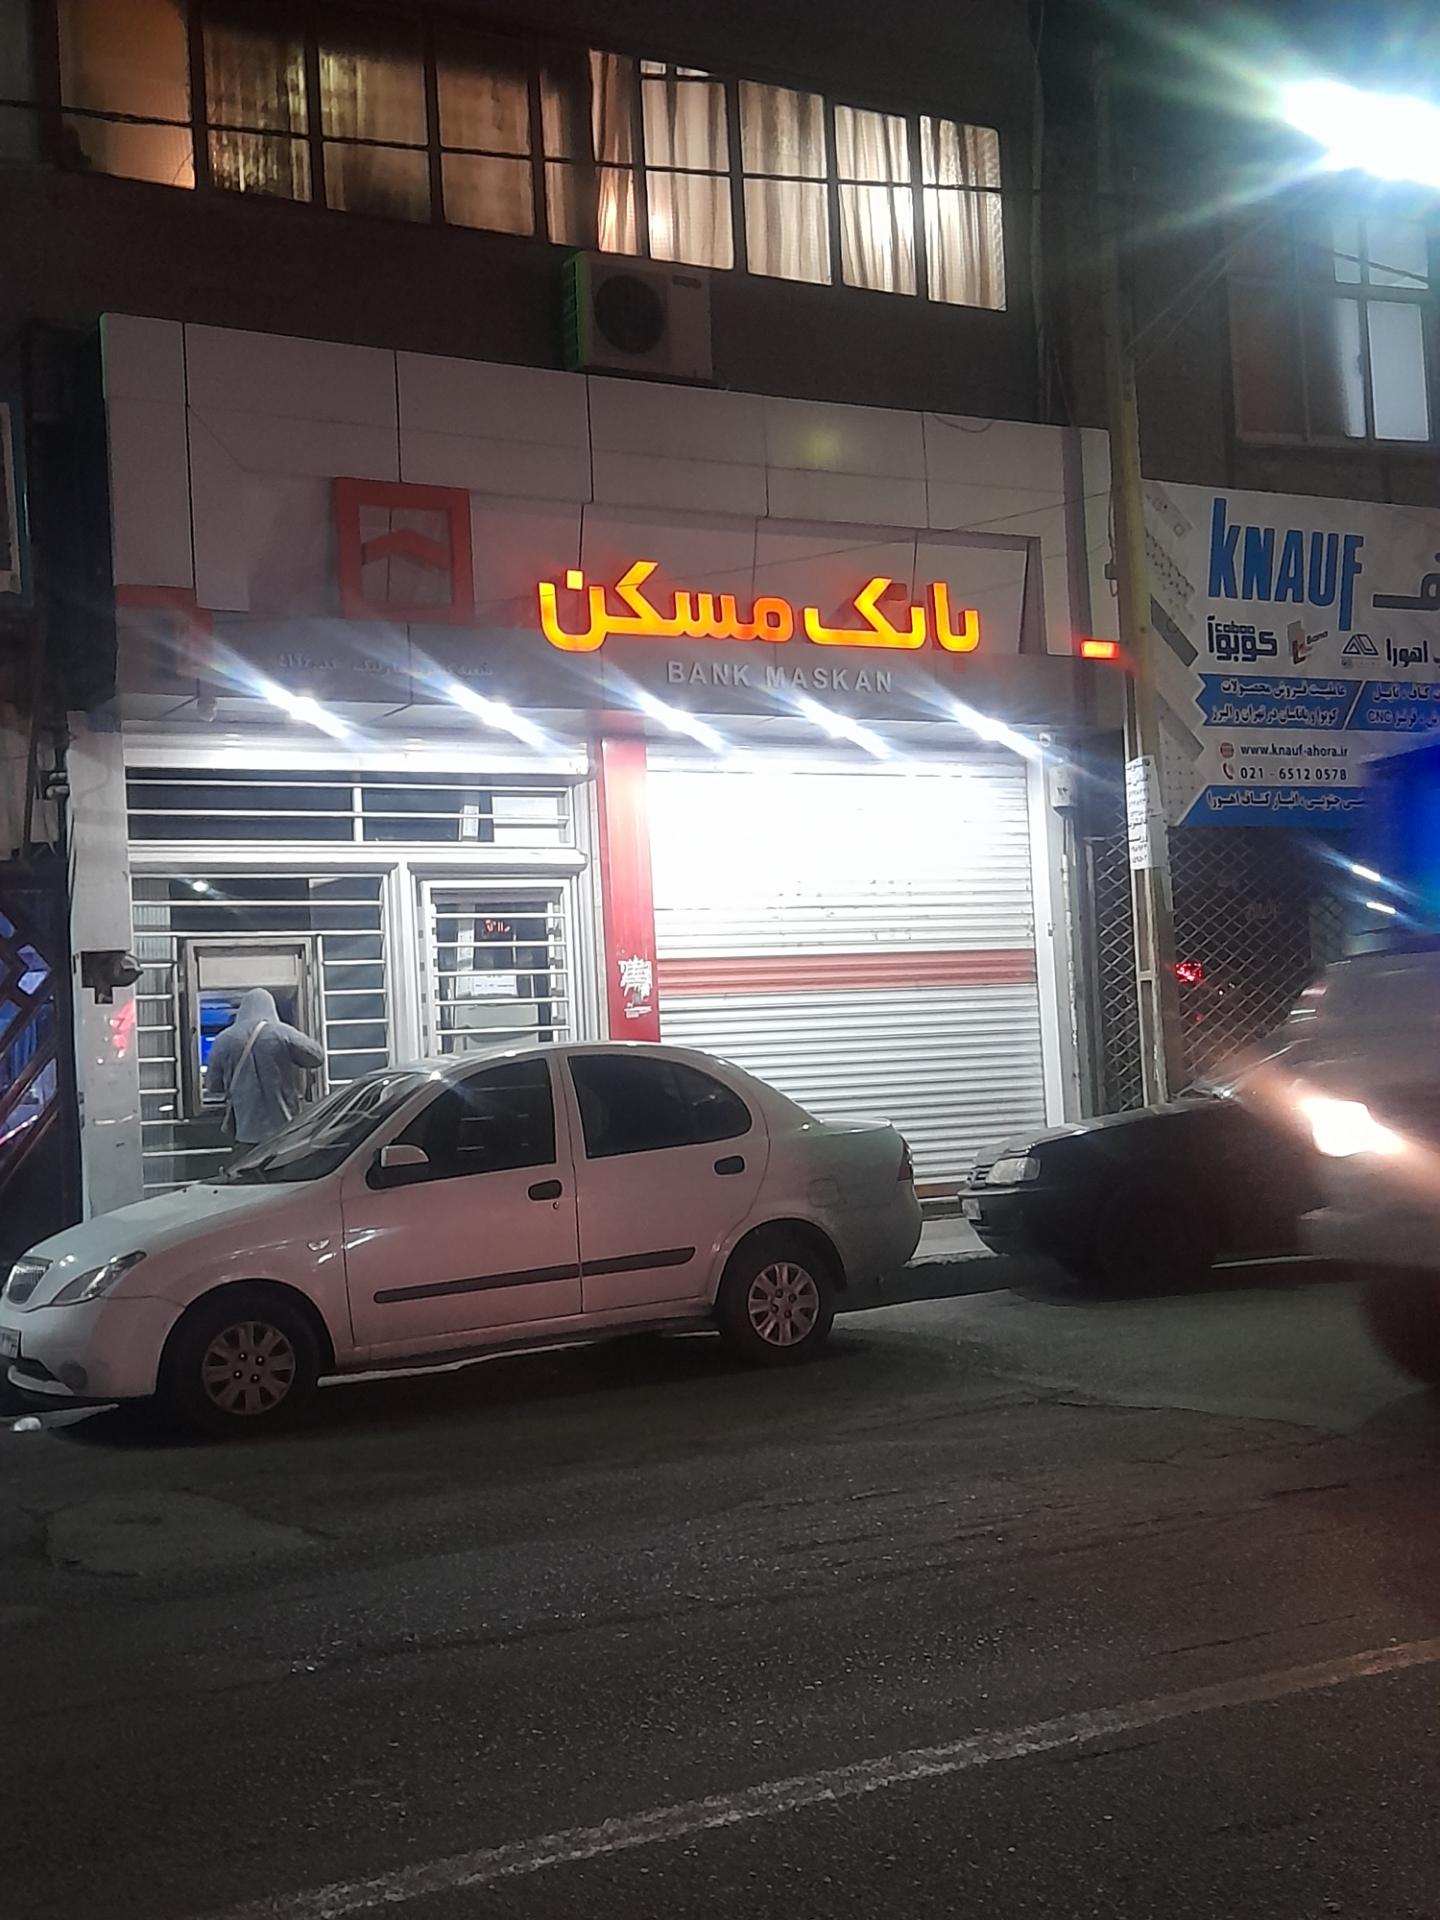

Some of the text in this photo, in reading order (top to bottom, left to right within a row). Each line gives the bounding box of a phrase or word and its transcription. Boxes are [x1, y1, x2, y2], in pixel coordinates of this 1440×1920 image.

[1208, 498, 1364, 631] KNAUF
[537, 560, 981, 653] بانک مسکن
[1386, 638, 1428, 667] اهورا
[667, 660, 893, 693] BANK MASKAN
[1221, 678, 1272, 698] محصولات
[1240, 743, 1348, 757] www.knauf-ahora.ir
[1240, 767, 1264, 780] 021
[1279, 768, 1310, 780] 6512
[1315, 768, 1347, 780] 0578
